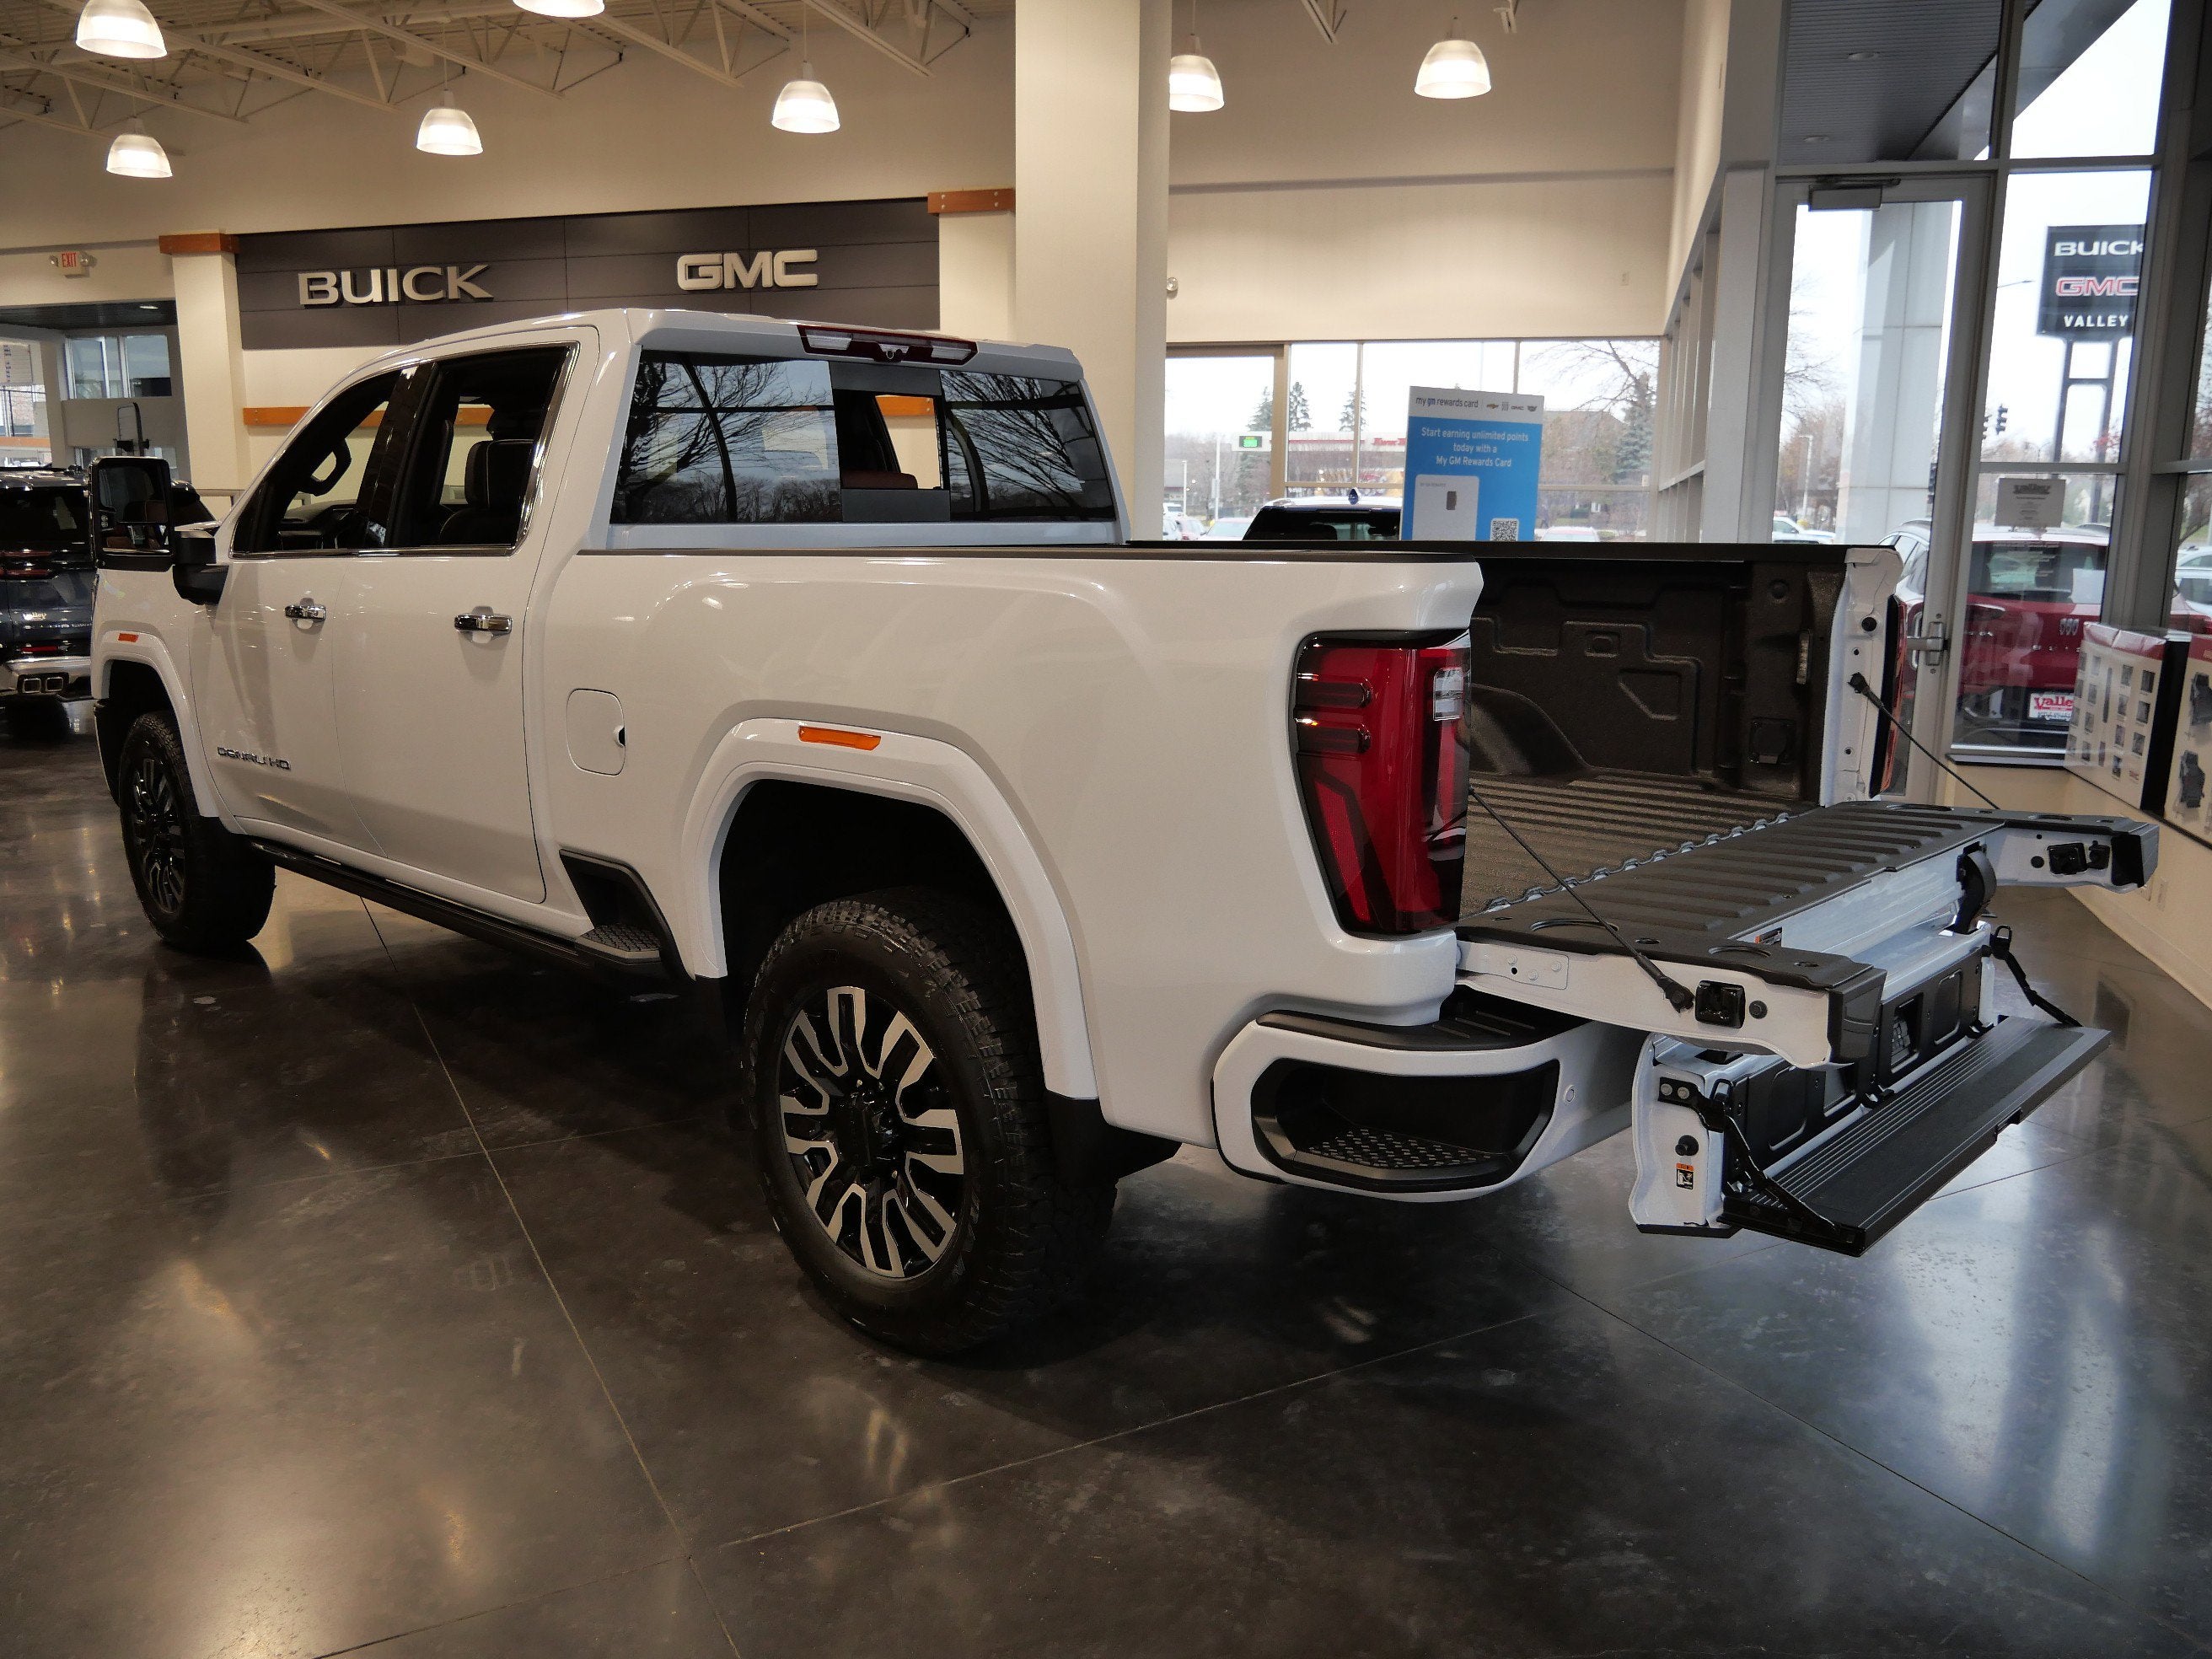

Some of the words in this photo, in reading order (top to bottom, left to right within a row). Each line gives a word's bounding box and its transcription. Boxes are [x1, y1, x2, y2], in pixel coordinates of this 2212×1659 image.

[2054, 240, 2144, 256] BUICK
[62, 252, 77, 267] EXIT
[677, 249, 819, 291] GMC
[298, 263, 494, 305] BUICK
[2055, 276, 2140, 297] GMC
[2064, 314, 2129, 328] VALLEY
[1415, 397, 1426, 406] my
[1436, 398, 1463, 407] rewards
[1463, 400, 1479, 408] card
[1421, 427, 1441, 438] Start
[1442, 429, 1470, 440] earning
[1472, 430, 1505, 440] unlimited
[1506, 432, 1529, 442] points
[1453, 443, 1474, 454] today
[1476, 443, 1491, 453] with
[1436, 455, 1447, 466] My
[1449, 456, 1461, 465] GM
[1463, 456, 1493, 466] Rewards
[1495, 458, 1511, 467] Card
[2034, 695, 2074, 710] Valle
